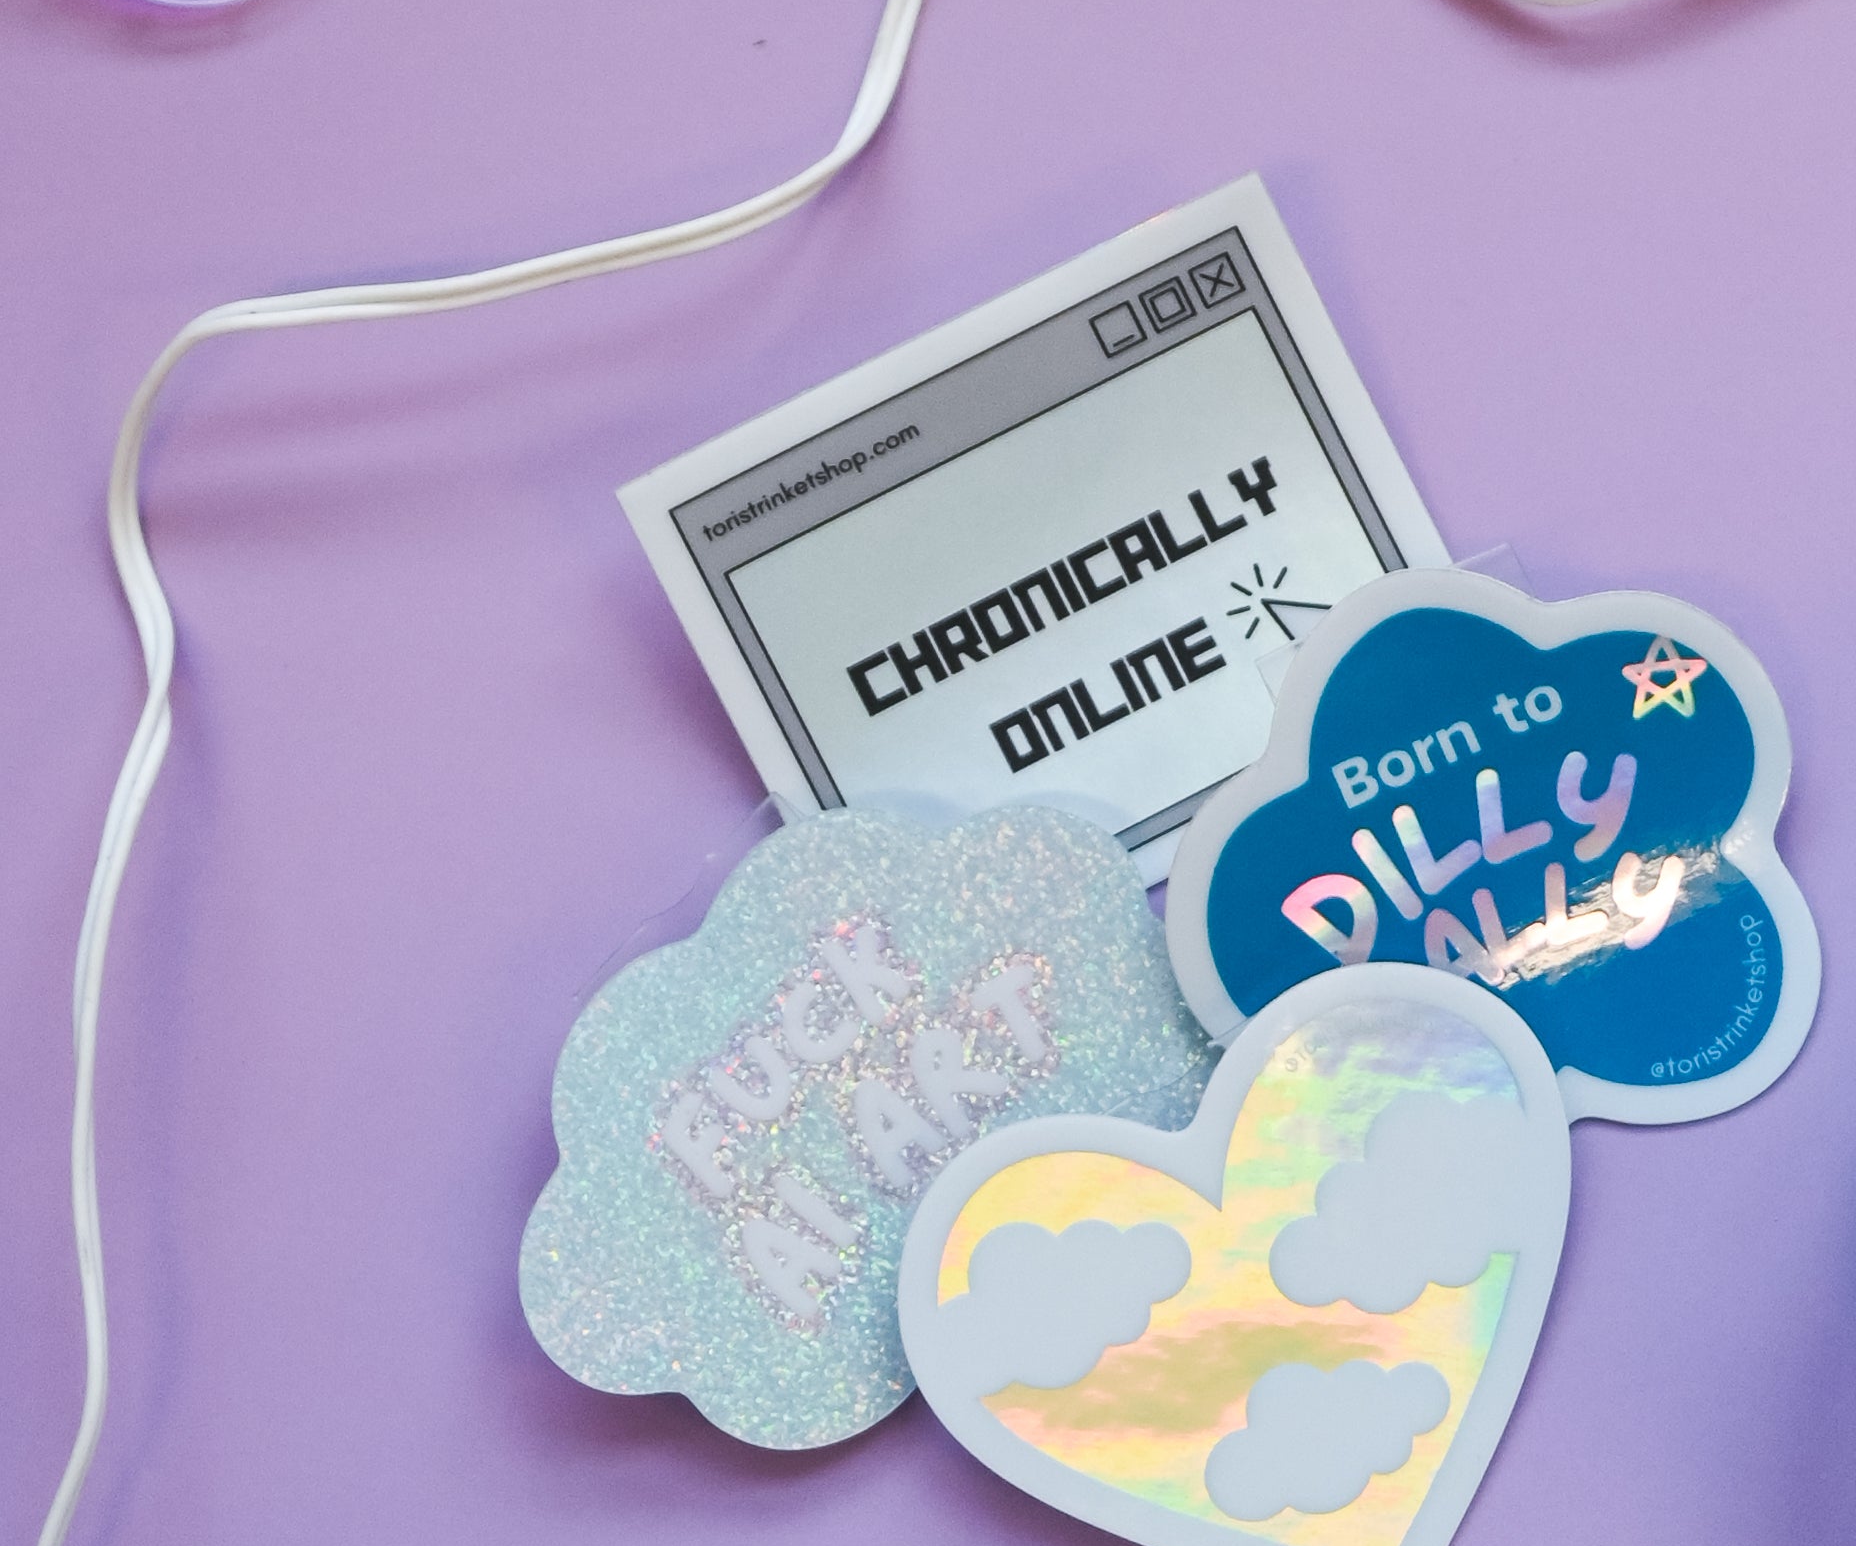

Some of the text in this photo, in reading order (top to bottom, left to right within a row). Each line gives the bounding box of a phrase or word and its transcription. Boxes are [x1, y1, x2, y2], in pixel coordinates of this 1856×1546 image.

[702, 424, 921, 542] toristrinketshop.com
[846, 454, 1279, 718] CHRONICALLY
[988, 616, 1228, 774] ONLINE
[1331, 685, 1563, 809] Born to
[1280, 750, 1638, 967] DILLY
[665, 923, 913, 1200] FUCK
[1650, 914, 1768, 1078] @toristrinketshop
[741, 963, 1048, 1320] AI ART
